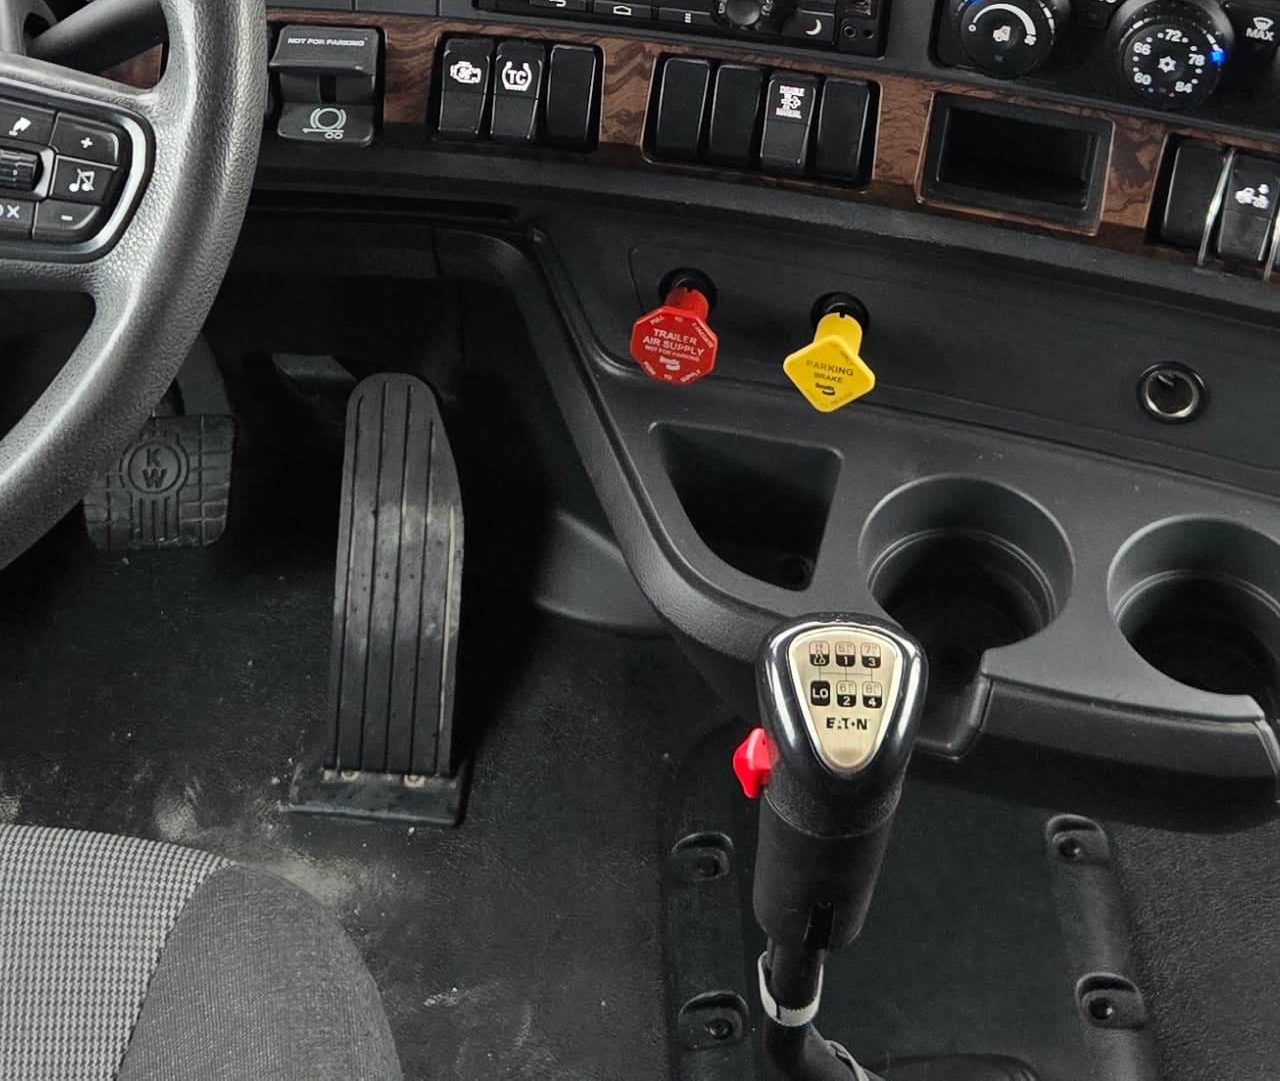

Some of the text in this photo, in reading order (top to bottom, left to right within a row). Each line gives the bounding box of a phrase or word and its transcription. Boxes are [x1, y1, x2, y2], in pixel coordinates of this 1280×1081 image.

[1165, 29, 1183, 42] 72
[1245, 26, 1275, 42] MAX
[1133, 42, 1152, 56] 66
[1187, 53, 1206, 67] 78
[507, 69, 528, 85] TC
[1133, 72, 1153, 87] 60
[1175, 80, 1193, 94] 84
[653, 328, 698, 346] TRAILER
[642, 335, 705, 357] AIR SUPPLY
[806, 359, 855, 377] PARKING
[813, 371, 843, 384] BRAKE
[146, 447, 161, 468] K
[142, 468, 168, 489] W
[844, 655, 849, 666] 1
[867, 657, 876, 667] 3
[812, 687, 829, 699] LO
[842, 695, 851, 706] 2
[868, 697, 877, 707] 4
